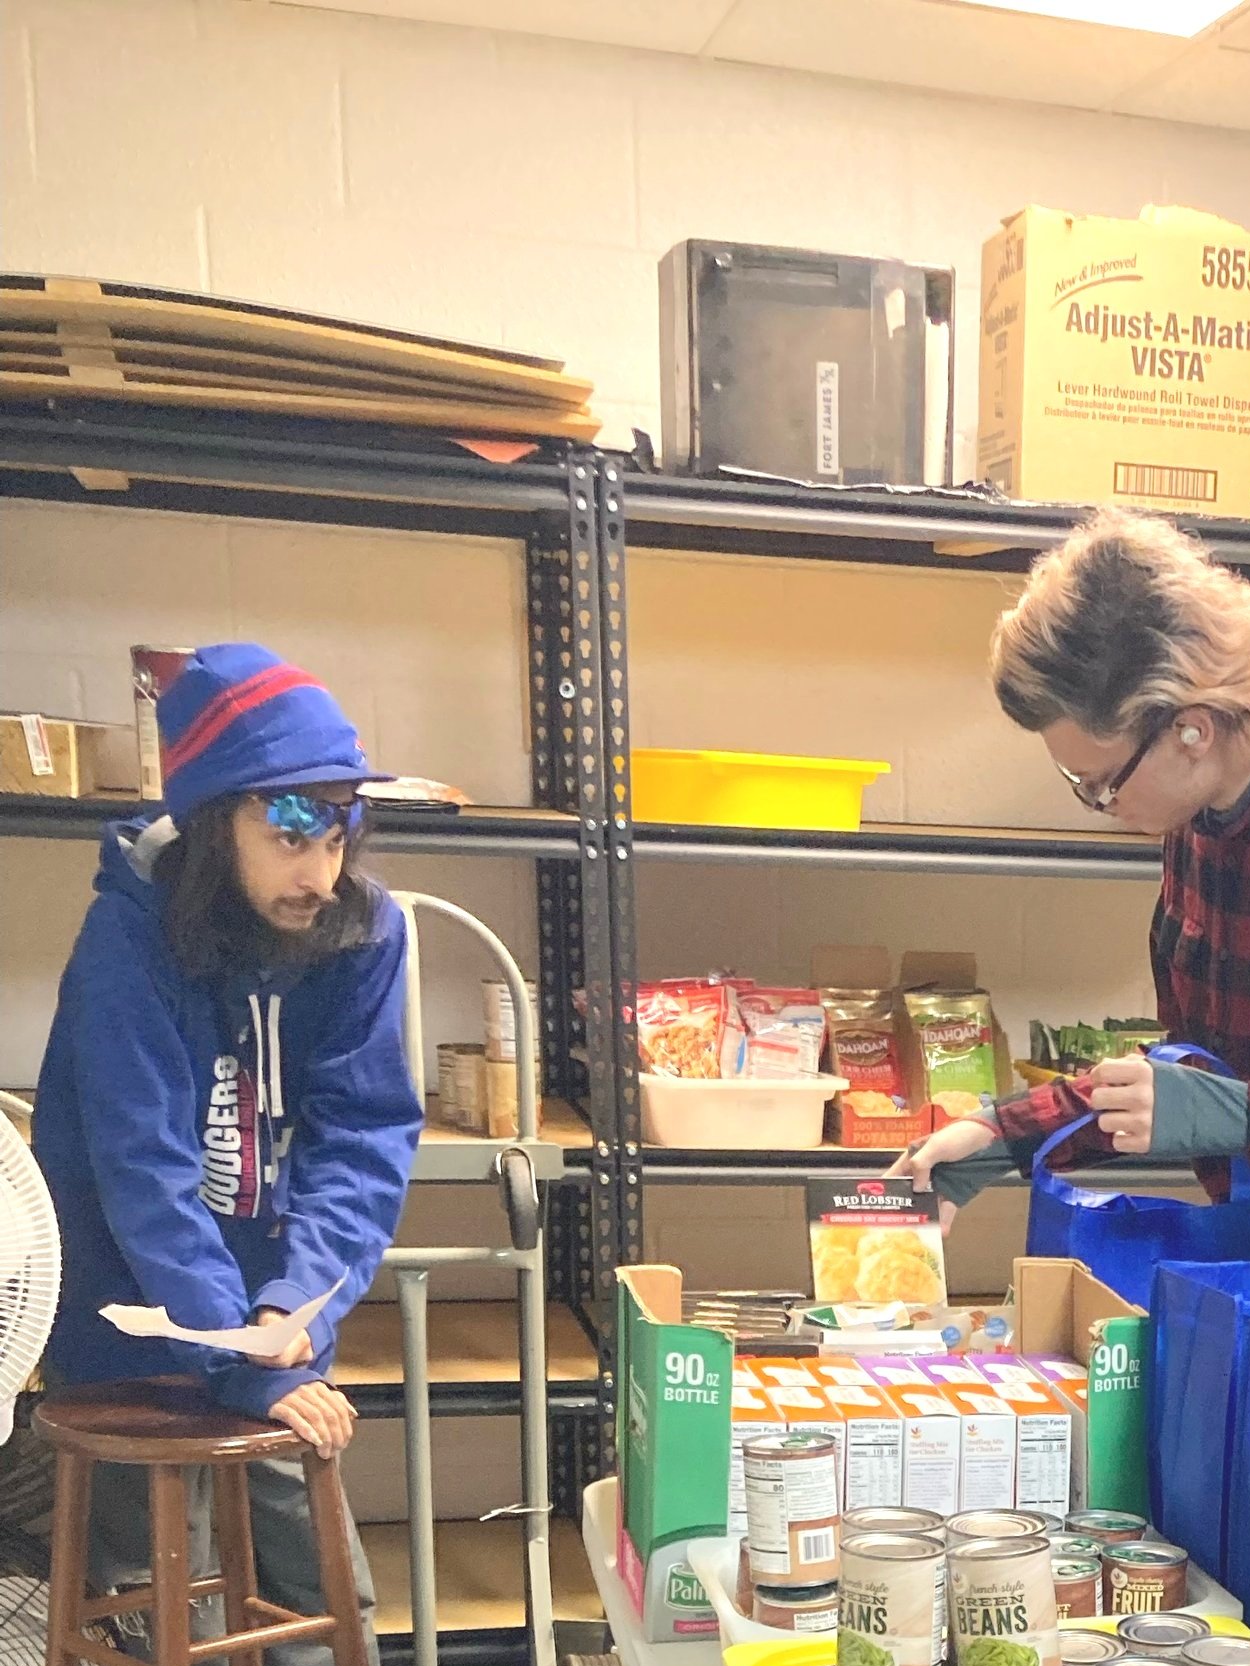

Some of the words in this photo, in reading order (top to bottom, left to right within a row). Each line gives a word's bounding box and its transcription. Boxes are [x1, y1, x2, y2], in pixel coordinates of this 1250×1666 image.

[1054, 275, 1077, 297] New
[1079, 266, 1088, 280] &
[1089, 253, 1137, 277] Improved
[822, 387, 833, 430] JAMES
[1057, 380, 1089, 396] Lever
[1092, 383, 1156, 402] Hardwound
[1161, 390, 1183, 405] Roll
[1186, 392, 1220, 409] Towel
[822, 435, 833, 470] FORT
[197, 1054, 243, 1216] DODGERS
[832, 1195, 860, 1208] RED
[860, 1193, 913, 1208] LOBSTER
[664, 1351, 704, 1387] 90
[705, 1372, 720, 1387] OZ
[1094, 1343, 1128, 1376] 90
[1128, 1359, 1141, 1372] OZ
[663, 1386, 720, 1405] BOTTLE
[1094, 1375, 1141, 1393] BOTTLE
[851, 1423, 880, 1431] Nutrition
[864, 1580, 890, 1596] style
[956, 1594, 1025, 1607] GREEN
[1000, 1580, 1025, 1596] style
[1112, 1587, 1164, 1615] FRUIT
[837, 1597, 888, 1635] EANS
[957, 1605, 1029, 1637] BEANS
